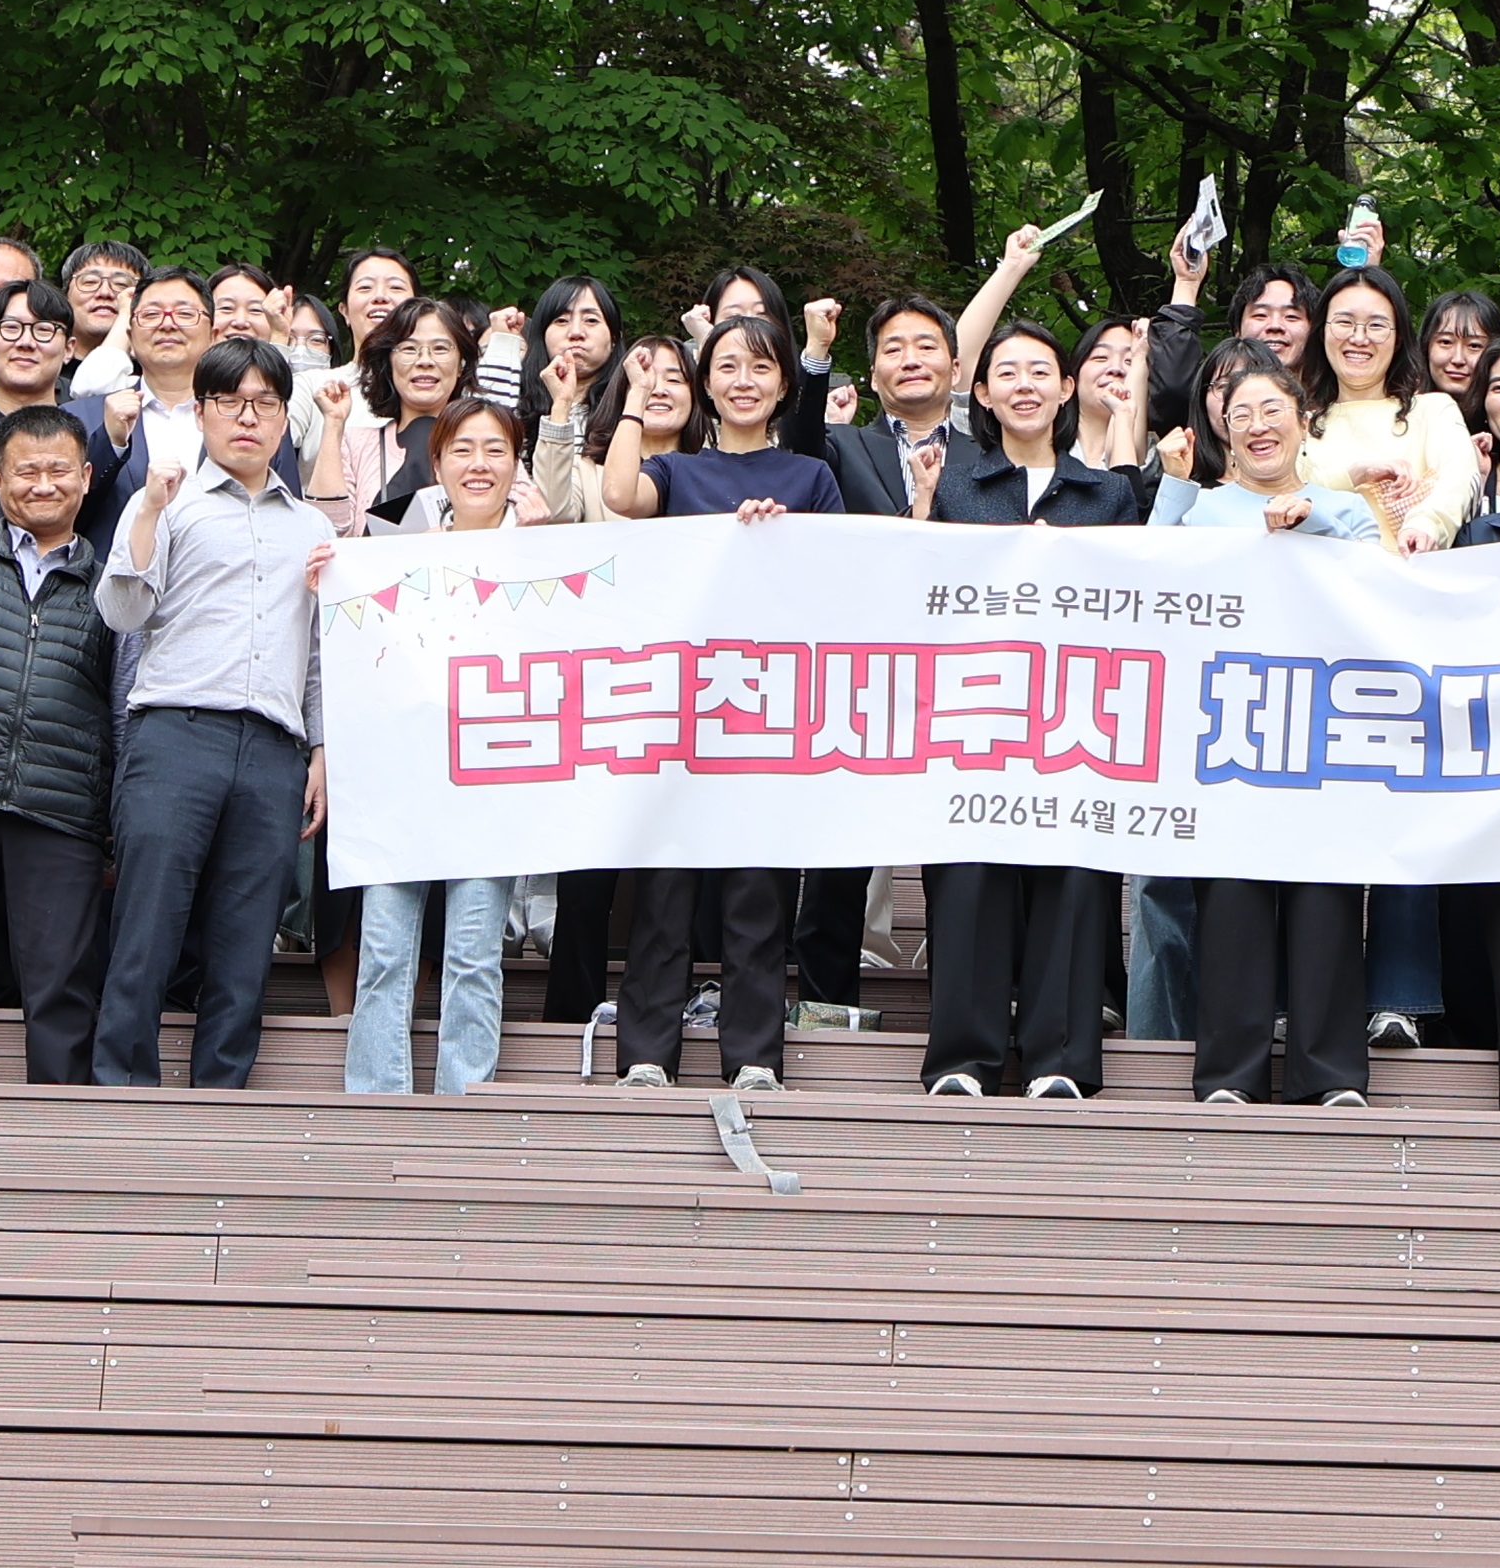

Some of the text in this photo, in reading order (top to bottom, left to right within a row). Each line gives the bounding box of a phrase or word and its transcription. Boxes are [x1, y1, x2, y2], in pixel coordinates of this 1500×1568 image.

[925, 582, 1246, 629] #오늘은 우리가 주인공
[452, 644, 1158, 778] 남부천세무서
[948, 793, 1198, 840] 2026년 4월 27일
